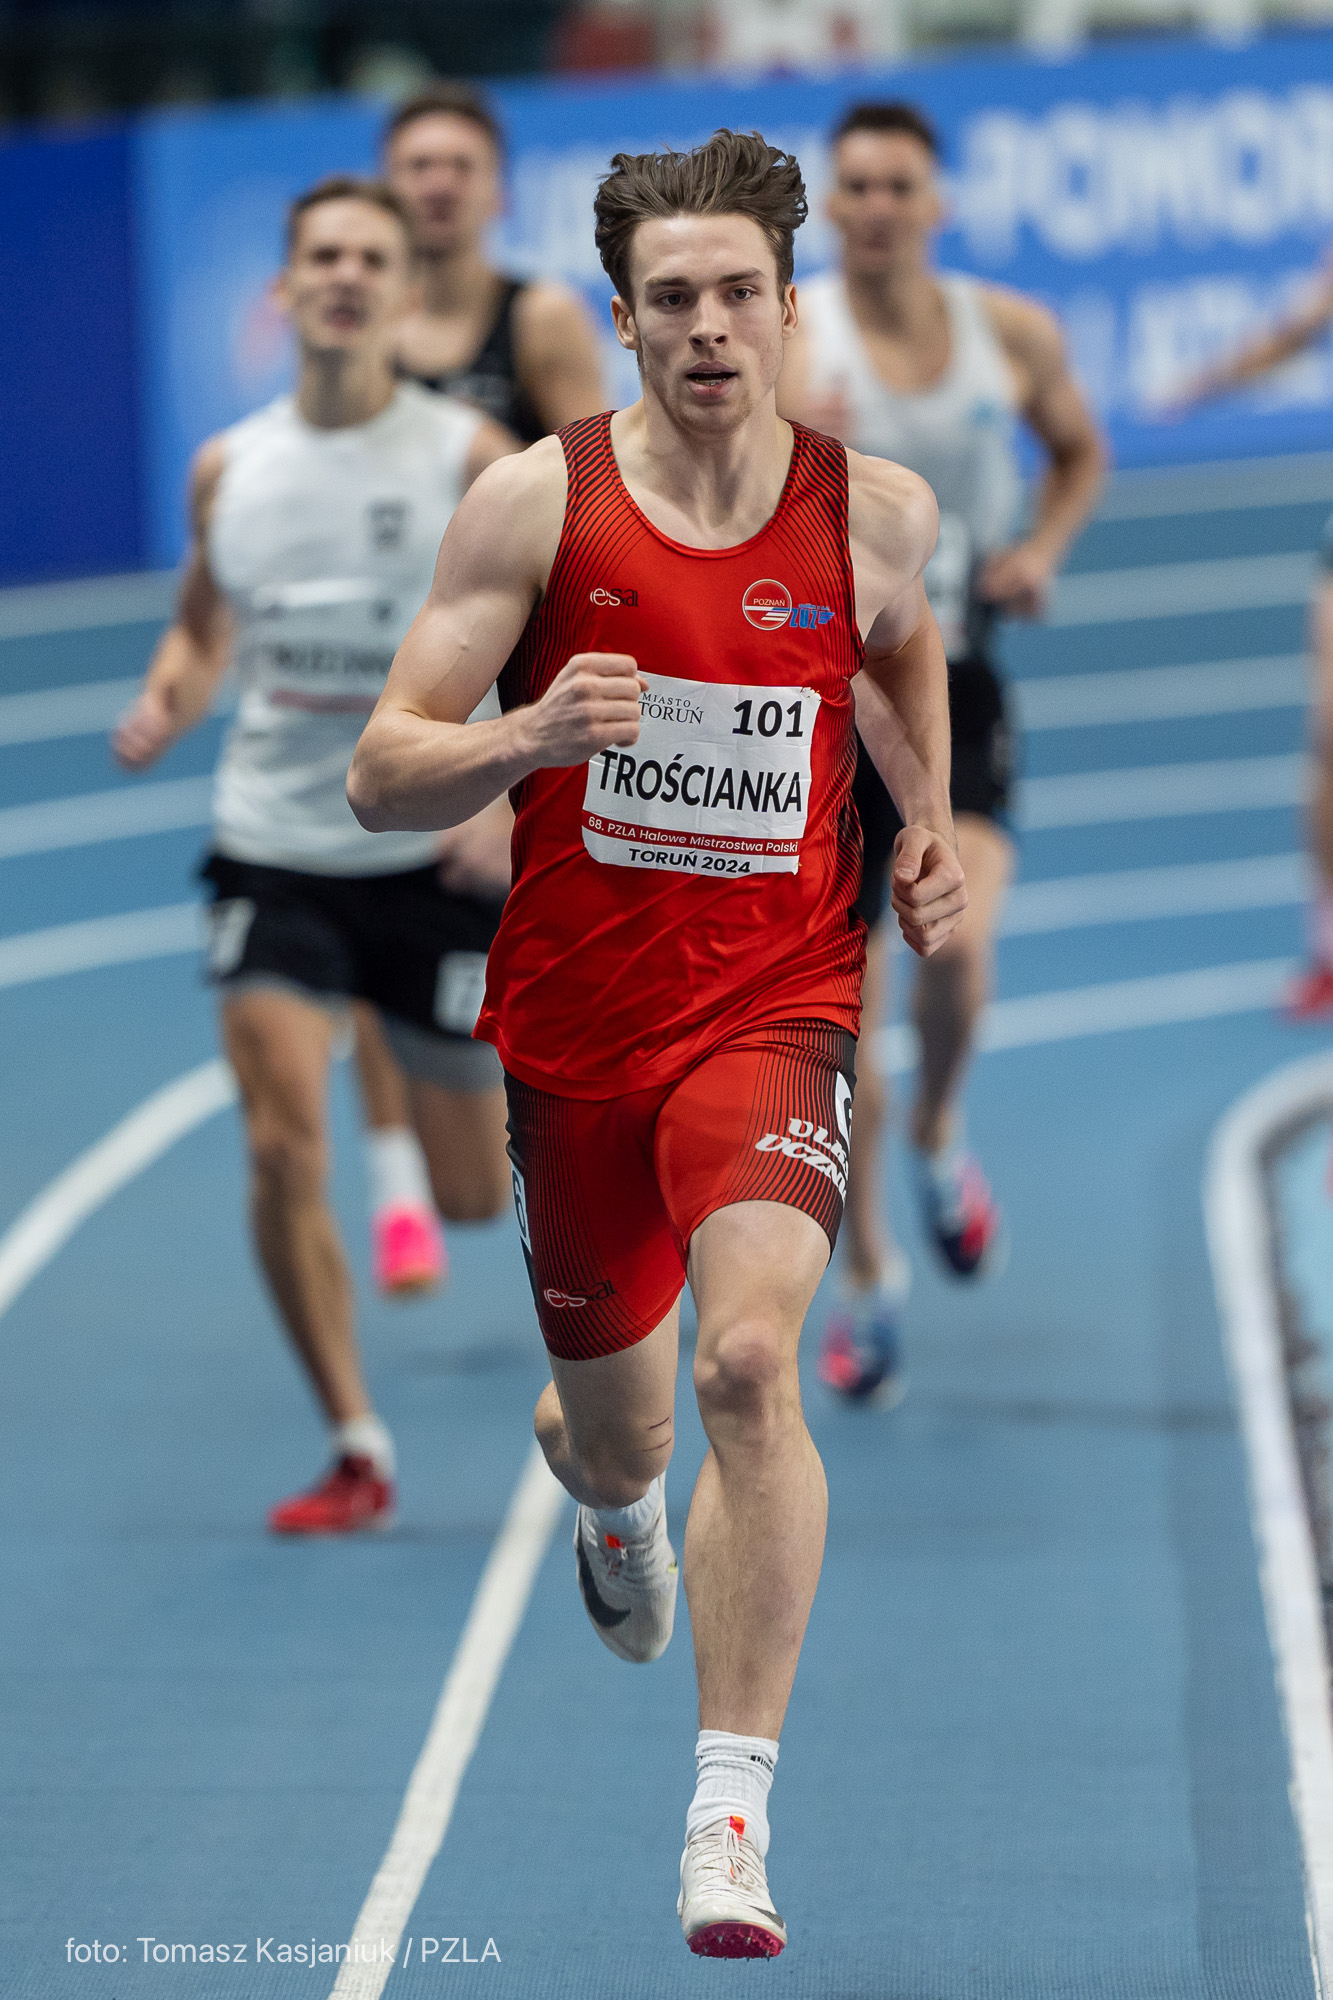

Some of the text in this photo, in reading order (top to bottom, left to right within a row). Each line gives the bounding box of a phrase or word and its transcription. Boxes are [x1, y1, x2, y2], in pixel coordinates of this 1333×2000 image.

[638, 700, 704, 725] TORUŃ
[642, 692, 691, 708] MIASTO
[732, 699, 804, 738] 101
[600, 749, 802, 813] TROŚCIANKA
[588, 816, 798, 853] 68. PZLA Halowe Mistrzostwa Polski
[628, 847, 750, 873] TORUŃ 2024
